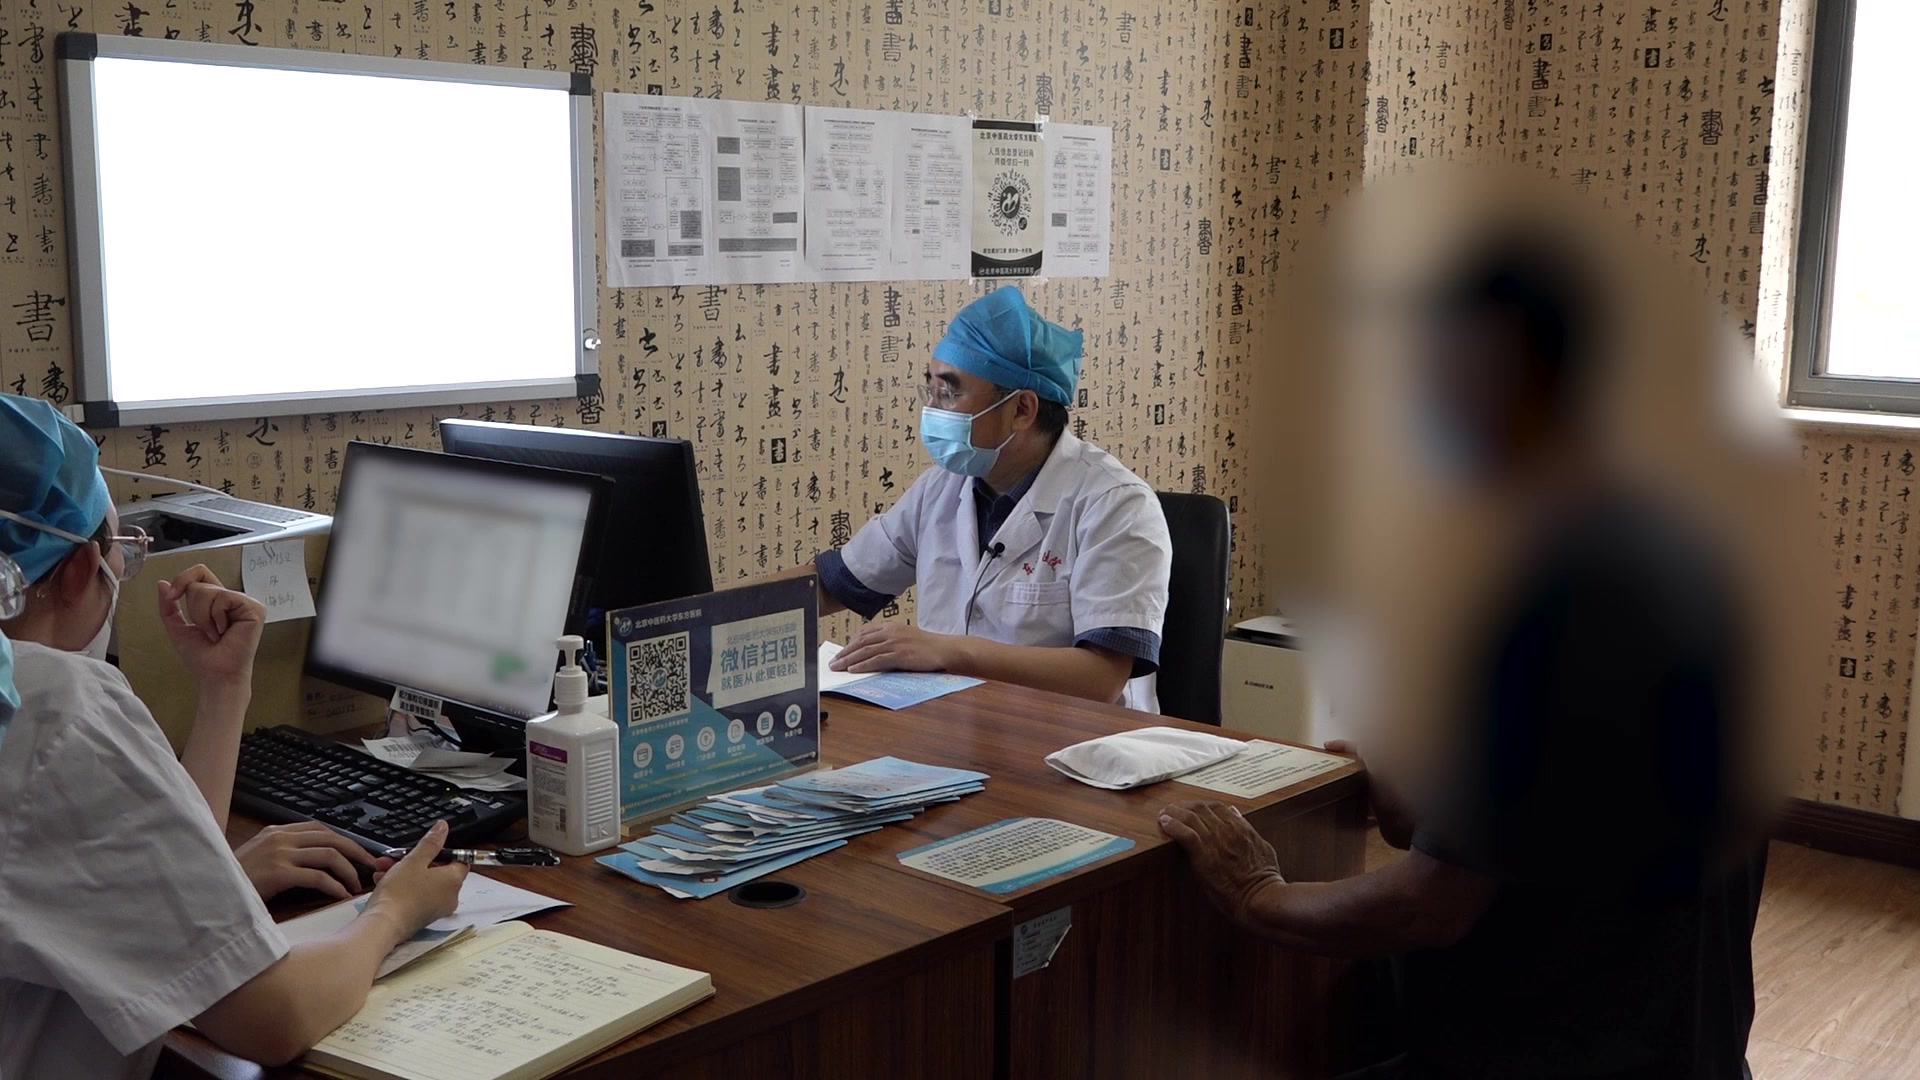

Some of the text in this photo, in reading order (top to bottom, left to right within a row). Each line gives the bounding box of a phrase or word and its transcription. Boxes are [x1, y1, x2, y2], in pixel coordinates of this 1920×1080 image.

[721, 635, 797, 674] 微信扫码
[721, 662, 798, 691] 就医从此更轻松
